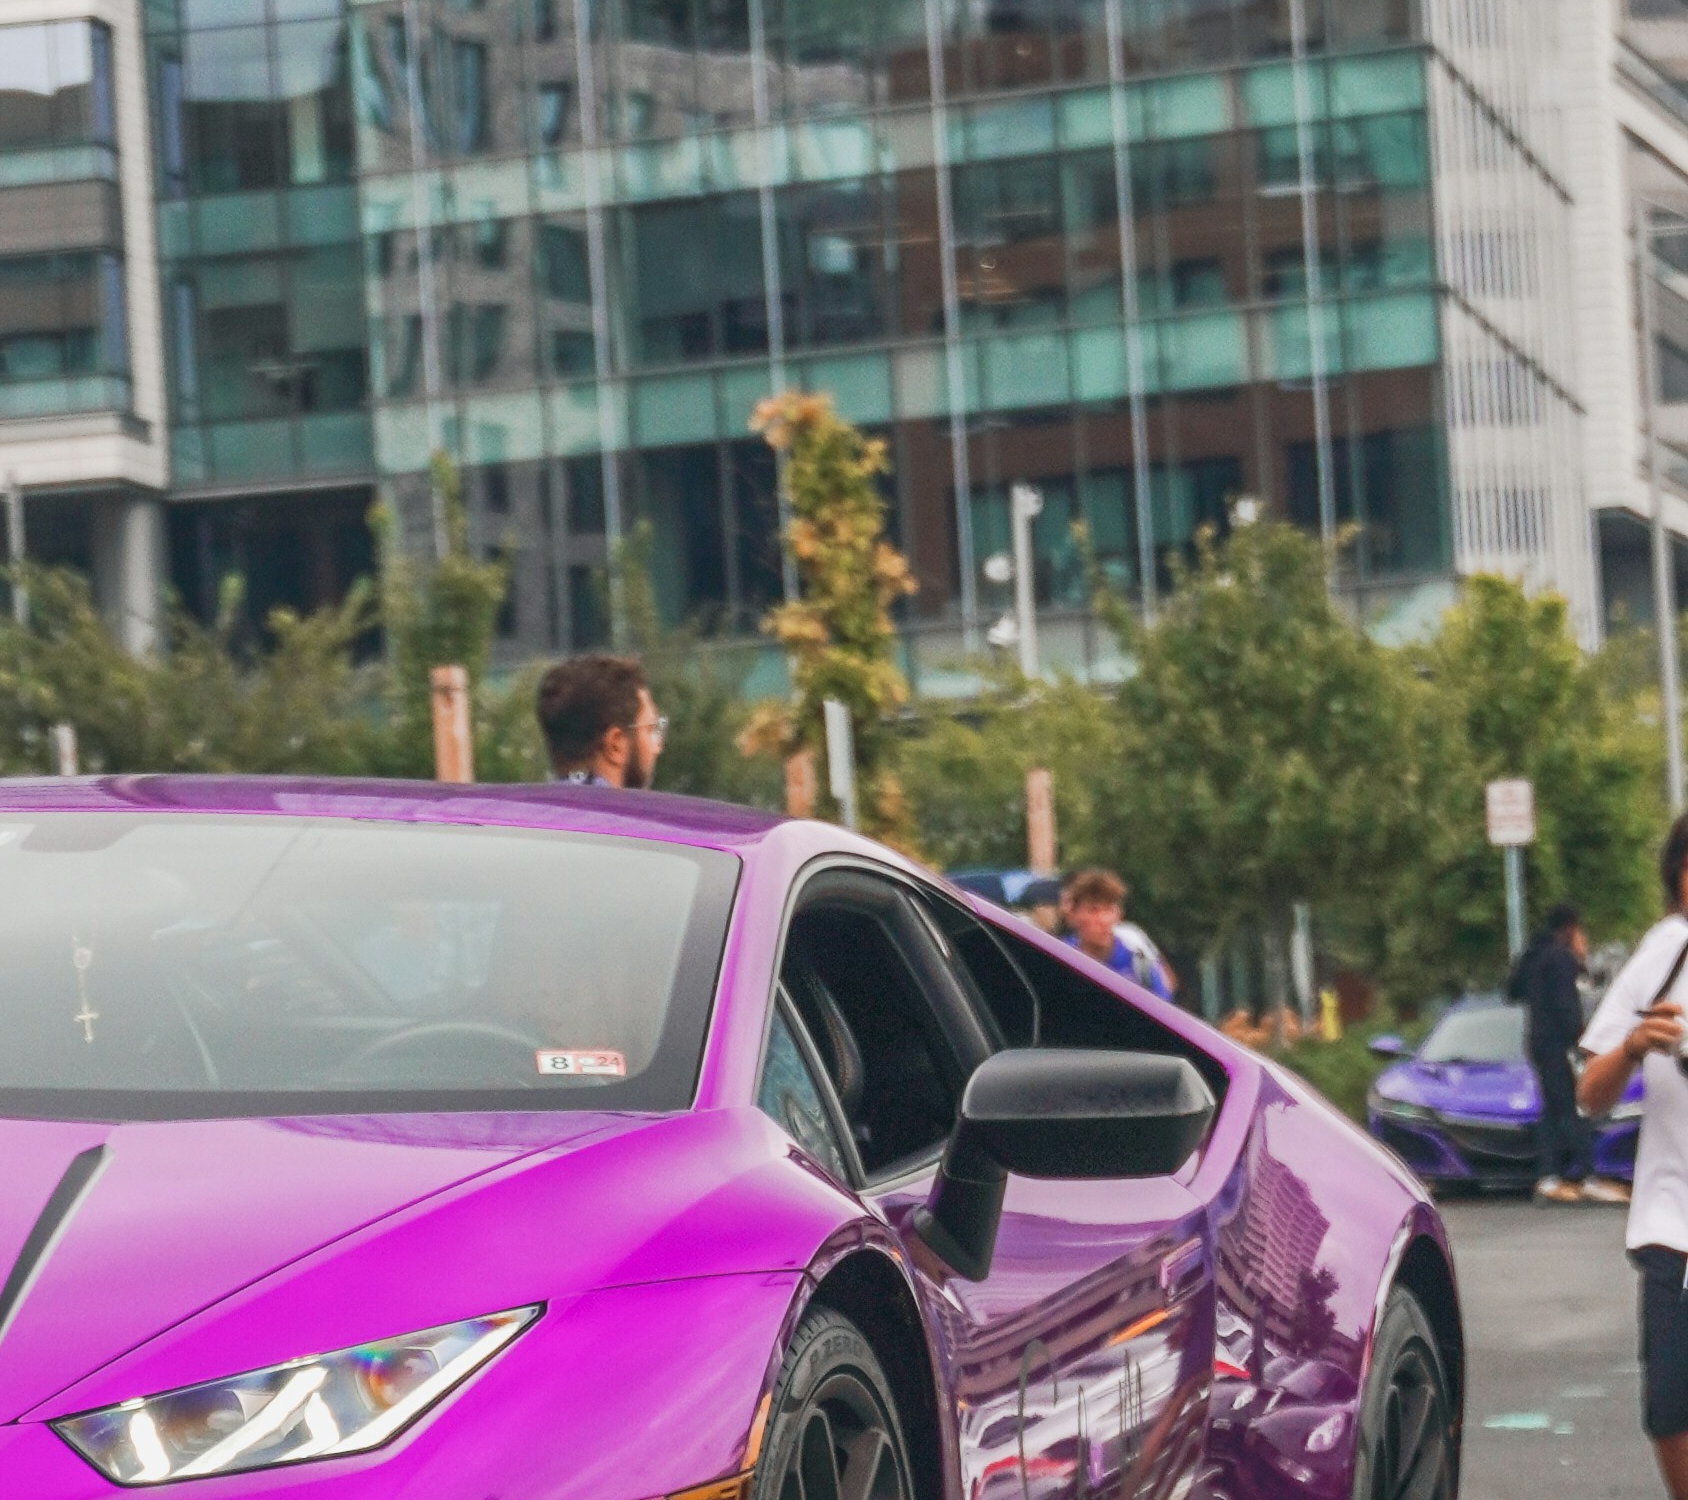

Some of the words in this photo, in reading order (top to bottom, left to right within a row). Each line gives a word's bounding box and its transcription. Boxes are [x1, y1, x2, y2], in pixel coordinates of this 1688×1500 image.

[552, 1057, 569, 1069] 8
[598, 1056, 620, 1066] 24
[822, 1334, 866, 1359] ZERO
